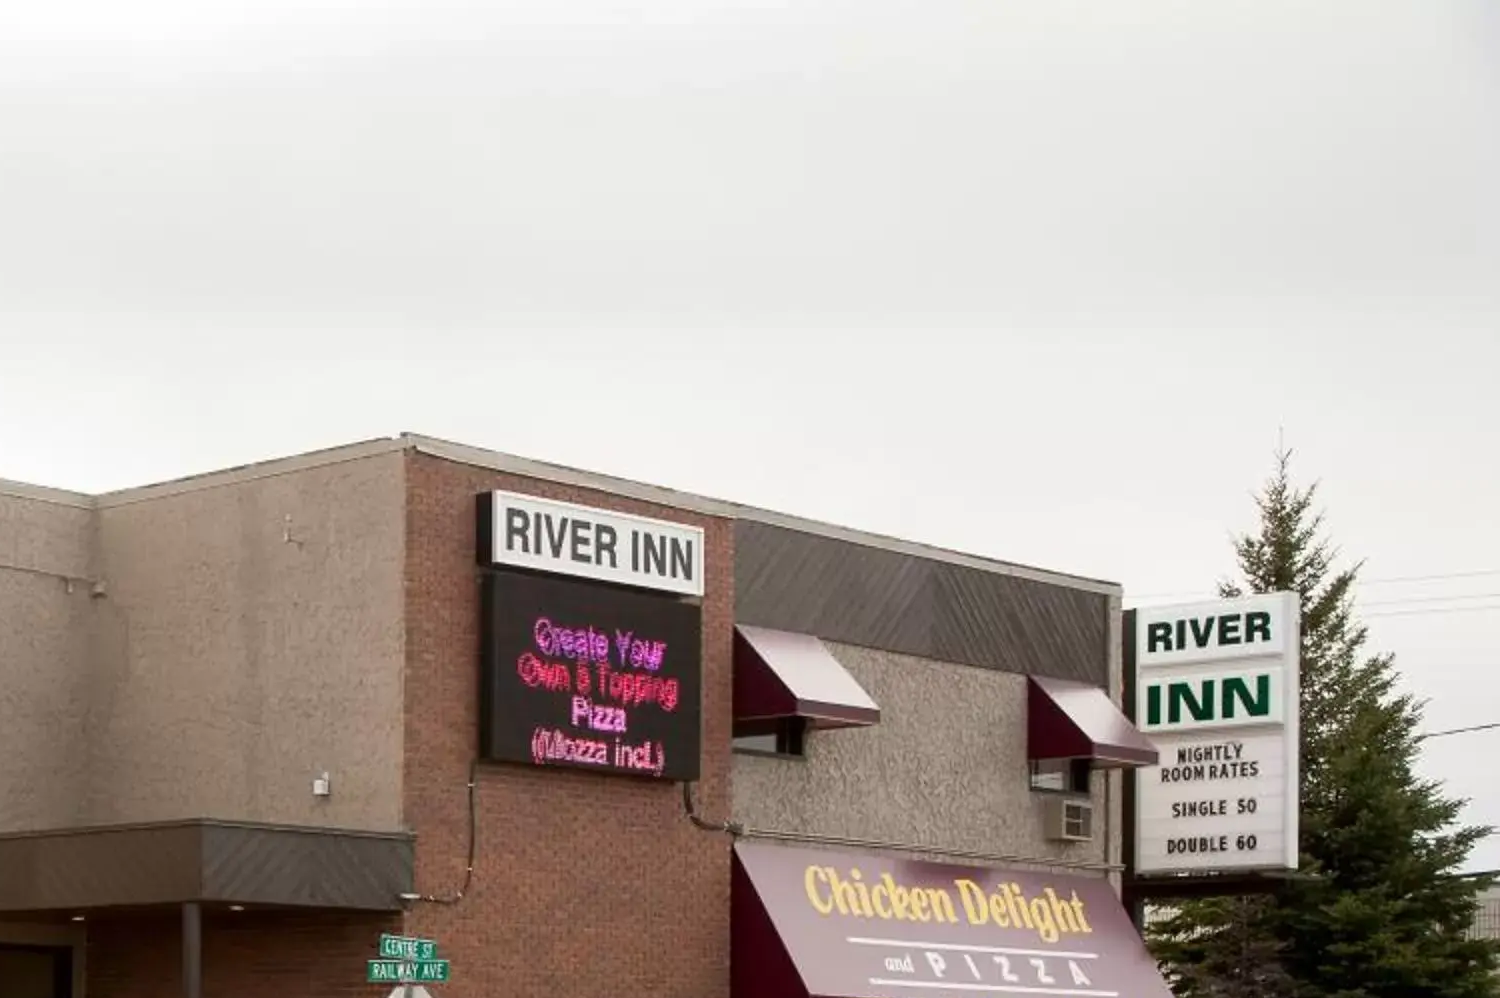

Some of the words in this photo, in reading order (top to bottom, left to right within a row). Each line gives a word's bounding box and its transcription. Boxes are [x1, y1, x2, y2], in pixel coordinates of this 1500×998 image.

[506, 507, 618, 568] RIVER
[631, 530, 693, 580] INN
[533, 617, 609, 661] Create
[615, 628, 667, 671] Your
[1147, 611, 1271, 653] RIVER
[516, 652, 571, 692] Own
[596, 656, 679, 711] Topping
[1147, 674, 1270, 725] INN
[571, 695, 627, 733] Pizza
[1161, 764, 1204, 783] ROOM
[1209, 761, 1259, 780] RATES
[1177, 744, 1243, 765] NIGHTLY
[1172, 800, 1226, 818] SINGLE
[1237, 799, 1257, 814] 50
[1167, 836, 1228, 854] DOUBLE
[1236, 835, 1257, 851] 60
[803, 864, 959, 924] Chicken
[954, 879, 1093, 944] Delight
[371, 963, 418, 979] RAILWAY
[421, 963, 444, 979] AVE
[884, 953, 914, 973] and
[924, 951, 1091, 987] PIZZA
